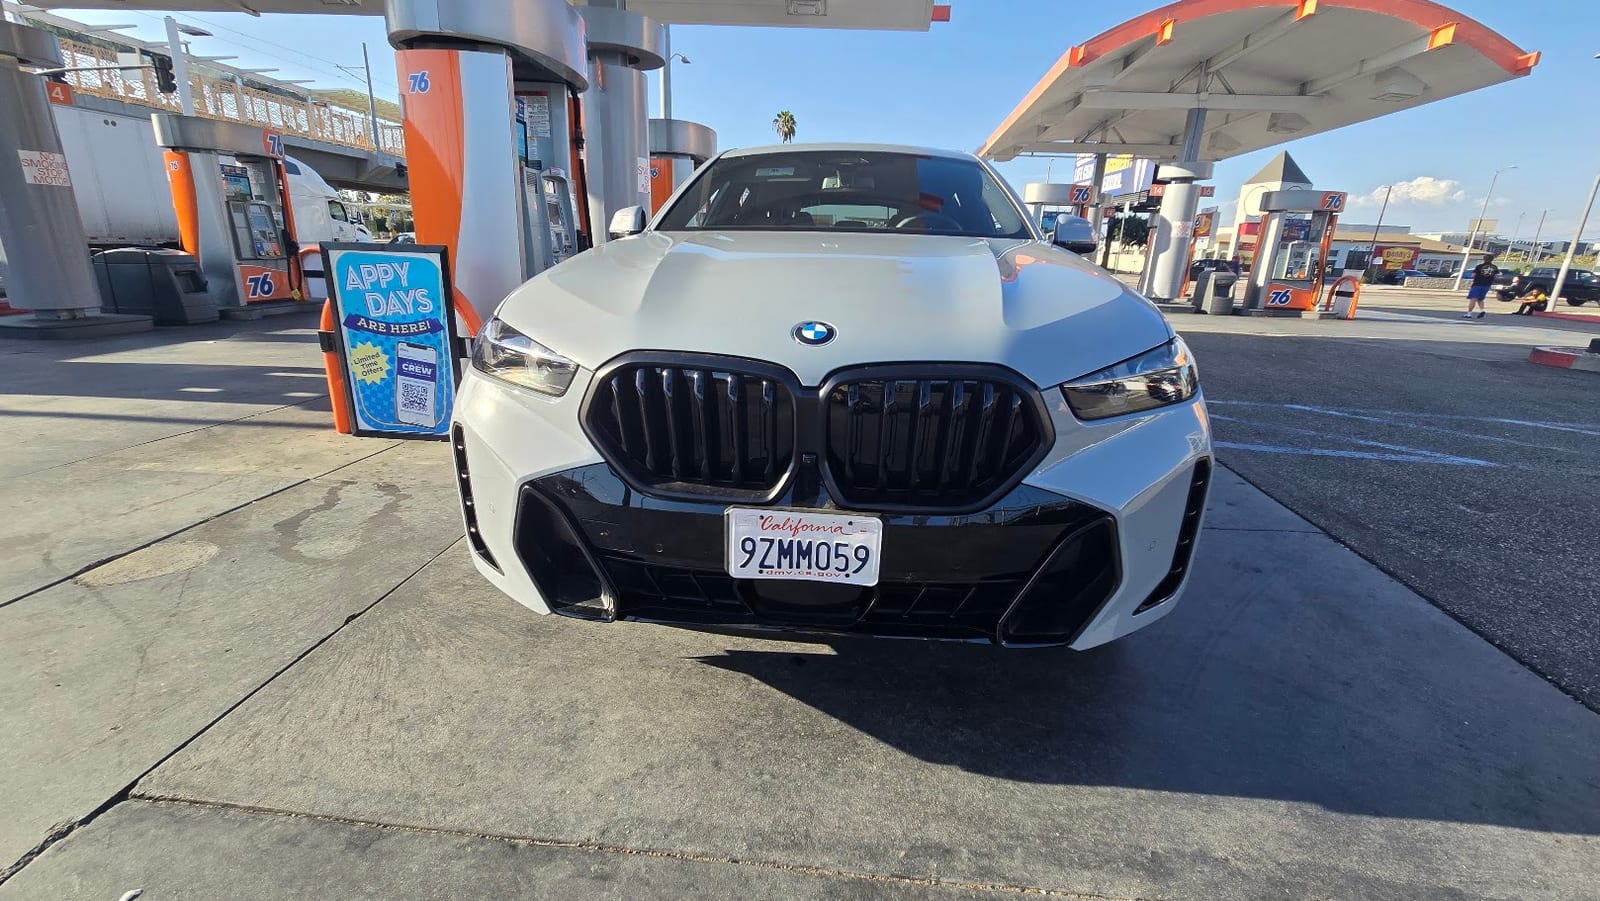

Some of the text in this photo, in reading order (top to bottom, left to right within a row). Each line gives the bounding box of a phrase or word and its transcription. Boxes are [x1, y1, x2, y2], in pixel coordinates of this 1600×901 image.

[408, 70, 430, 94] 76
[51, 86, 65, 101] 4
[267, 134, 285, 157] 76
[21, 158, 68, 170] SMOKING
[39, 151, 56, 161] NO
[37, 167, 63, 177] STOP
[169, 161, 179, 171] 76
[33, 175, 68, 185] MOTOR
[1072, 187, 1090, 203] 76
[1325, 194, 1342, 210] 76
[345, 261, 410, 291] APPY
[247, 271, 274, 298] 76
[364, 288, 434, 317] DAYS
[1268, 288, 1291, 306] 76
[356, 317, 431, 334] ARE HERE!
[353, 351, 381, 365] Limited
[360, 360, 378, 370] Time
[361, 366, 384, 377] Offers
[402, 363, 432, 376] CREW
[760, 514, 853, 537] California
[739, 536, 870, 574] 9ZMM059
